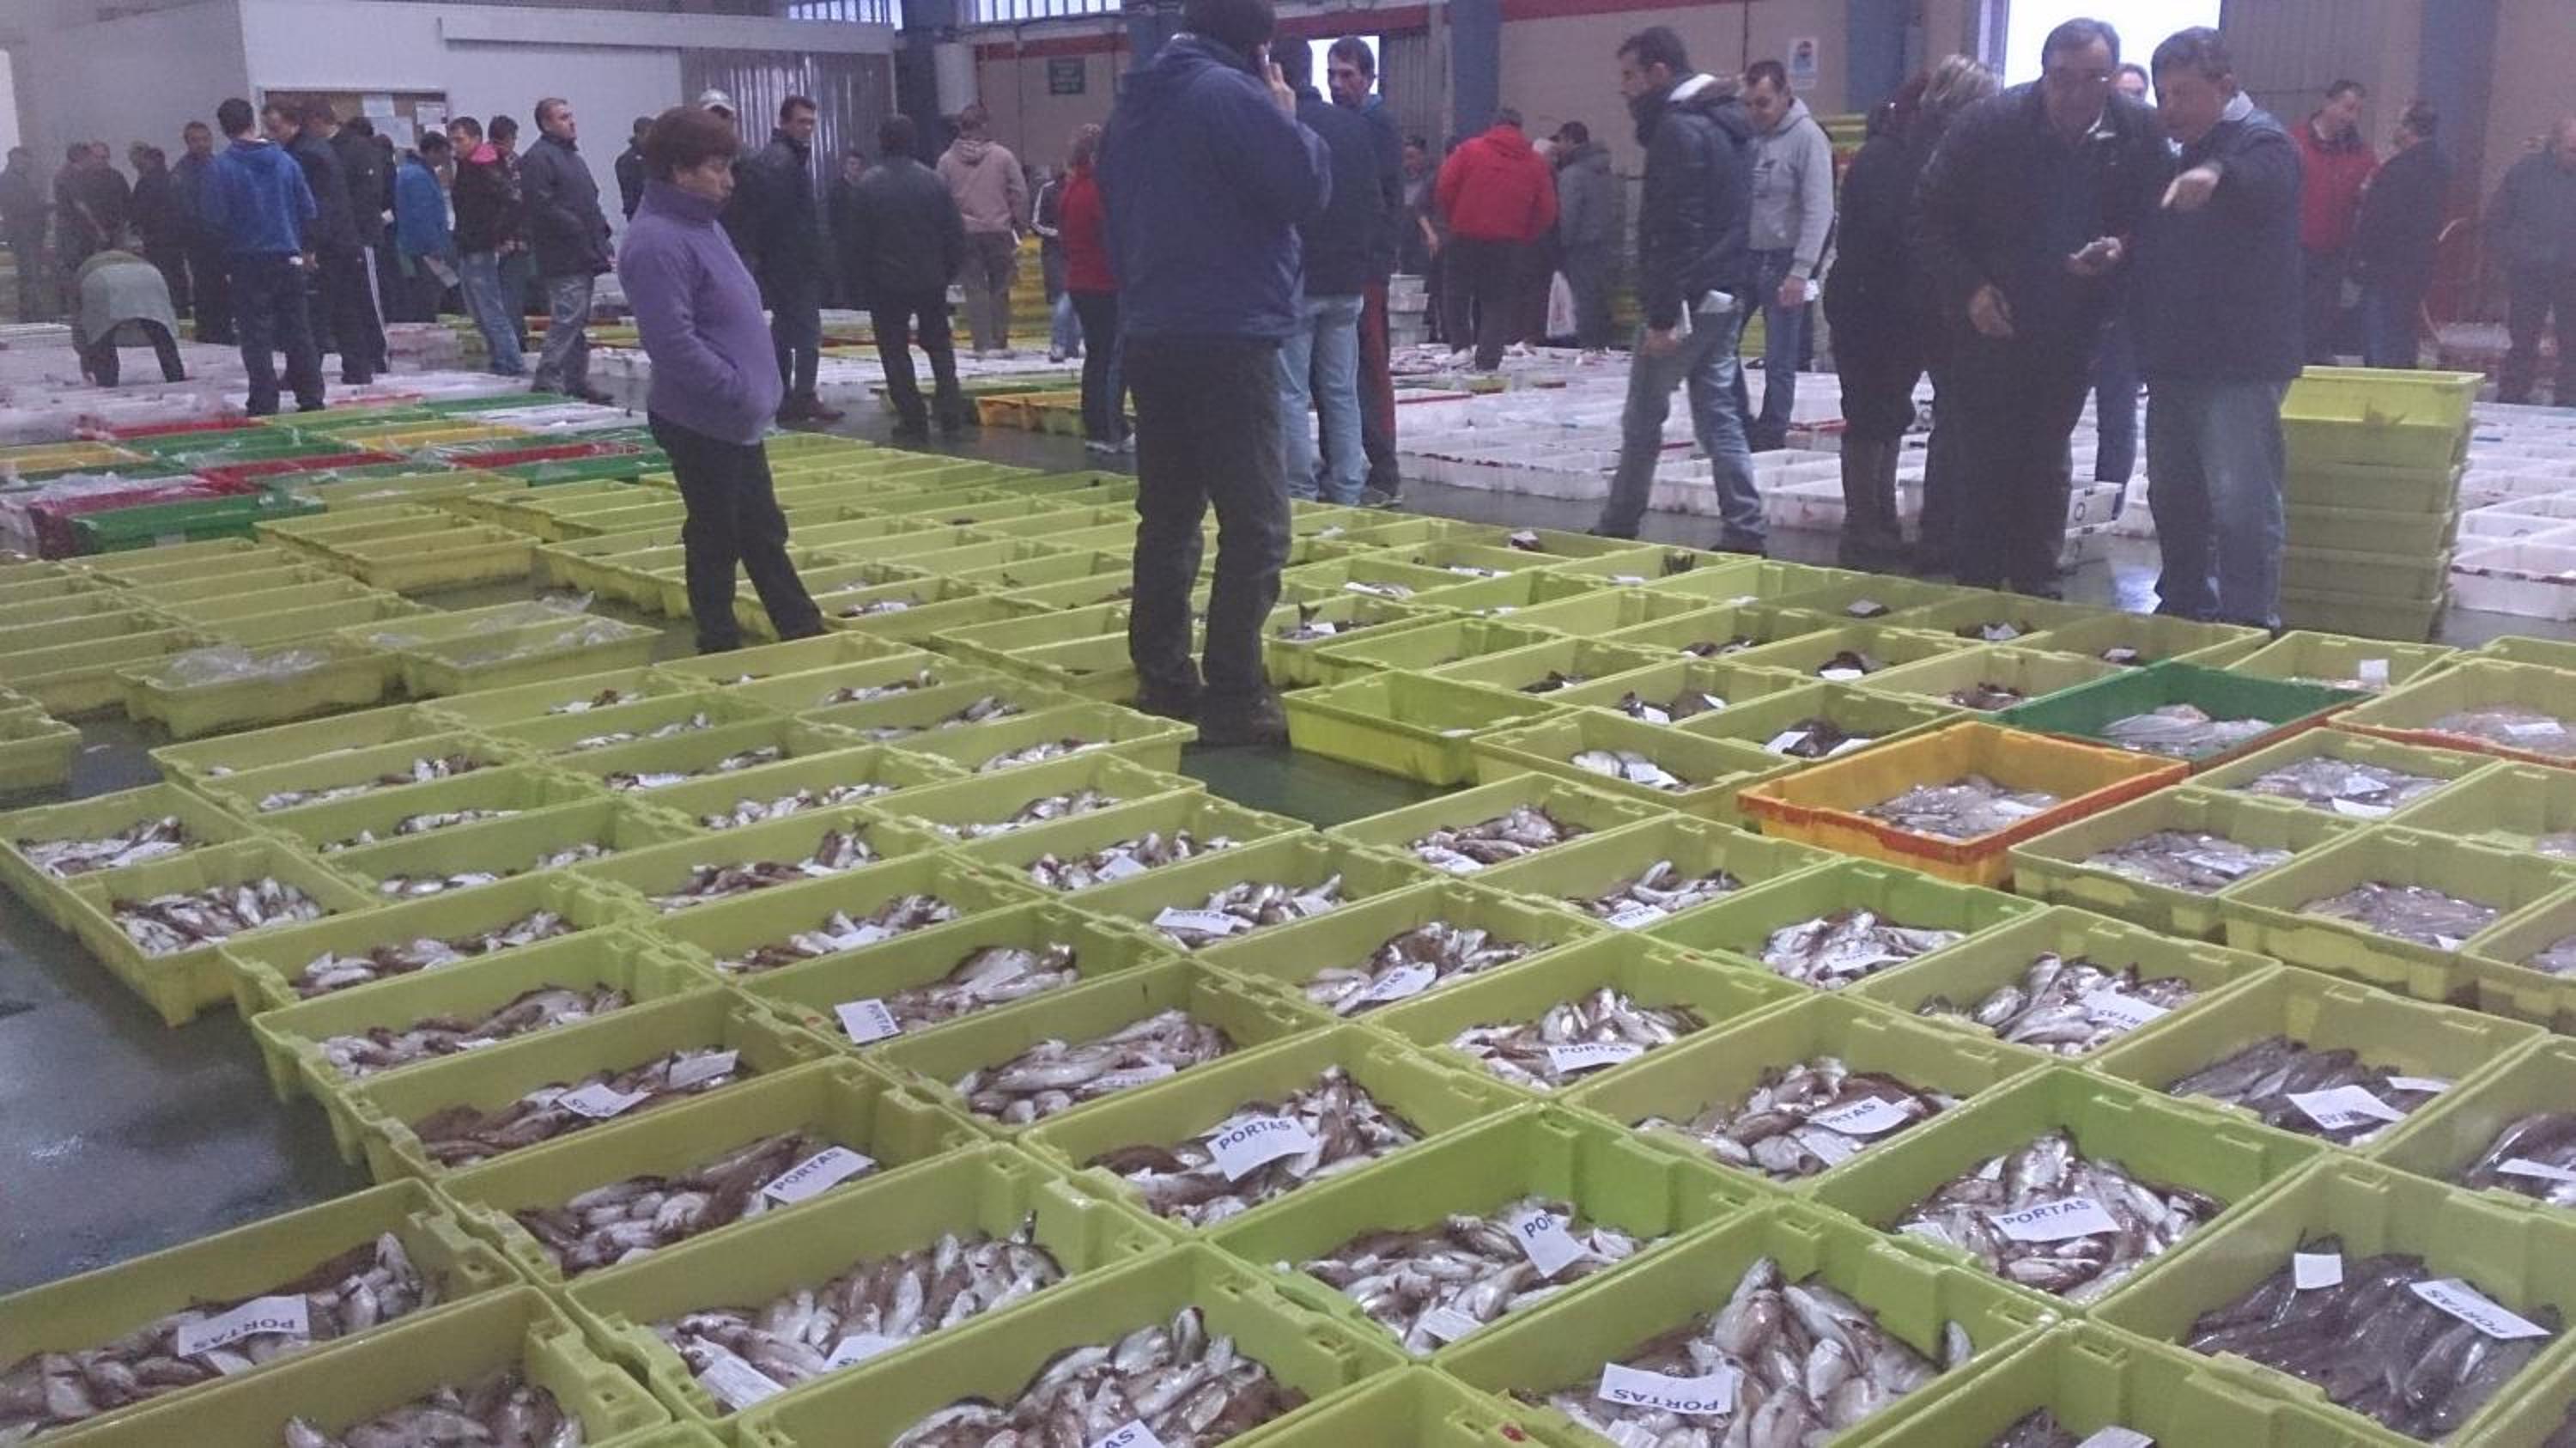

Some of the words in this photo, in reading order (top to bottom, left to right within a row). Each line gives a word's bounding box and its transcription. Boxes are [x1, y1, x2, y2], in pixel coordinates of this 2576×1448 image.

[1218, 1120, 1291, 1150] PORTAS
[773, 1151, 843, 1191] PORTAS
[2002, 1200, 2091, 1225] PORTAS
[191, 1318, 295, 1351] PORTAS
[1613, 1388, 1718, 1411] PORTAS
